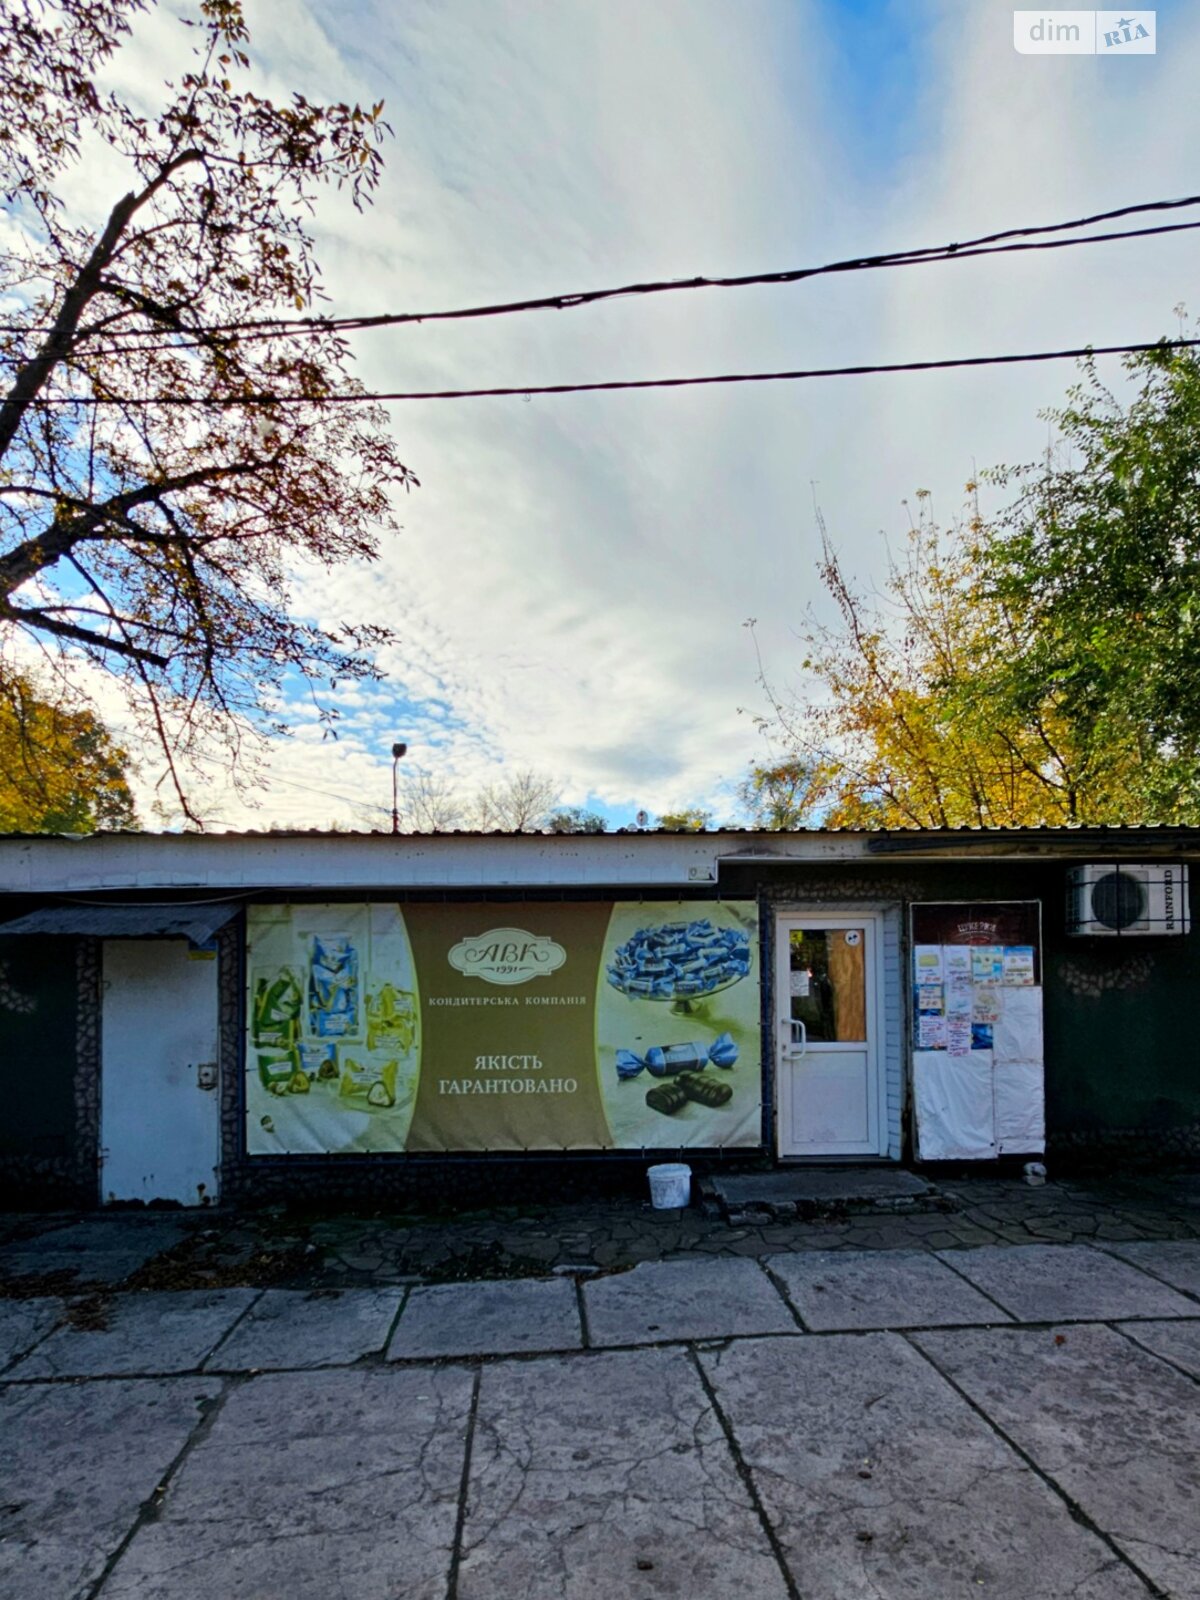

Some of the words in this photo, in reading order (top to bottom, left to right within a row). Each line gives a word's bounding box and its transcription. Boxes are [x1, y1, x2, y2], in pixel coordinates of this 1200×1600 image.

[1163, 869, 1175, 931] RAINFORD
[464, 942, 550, 963] АВК
[496, 965, 519, 975] 1991
[428, 997, 519, 1007] КОНДИТЕРСЬКА
[525, 996, 587, 1006] КОМПАНІЯ
[474, 1054, 543, 1071] ЯКІСТЬ
[438, 1078, 578, 1095] ГАРАНТОВАНО
